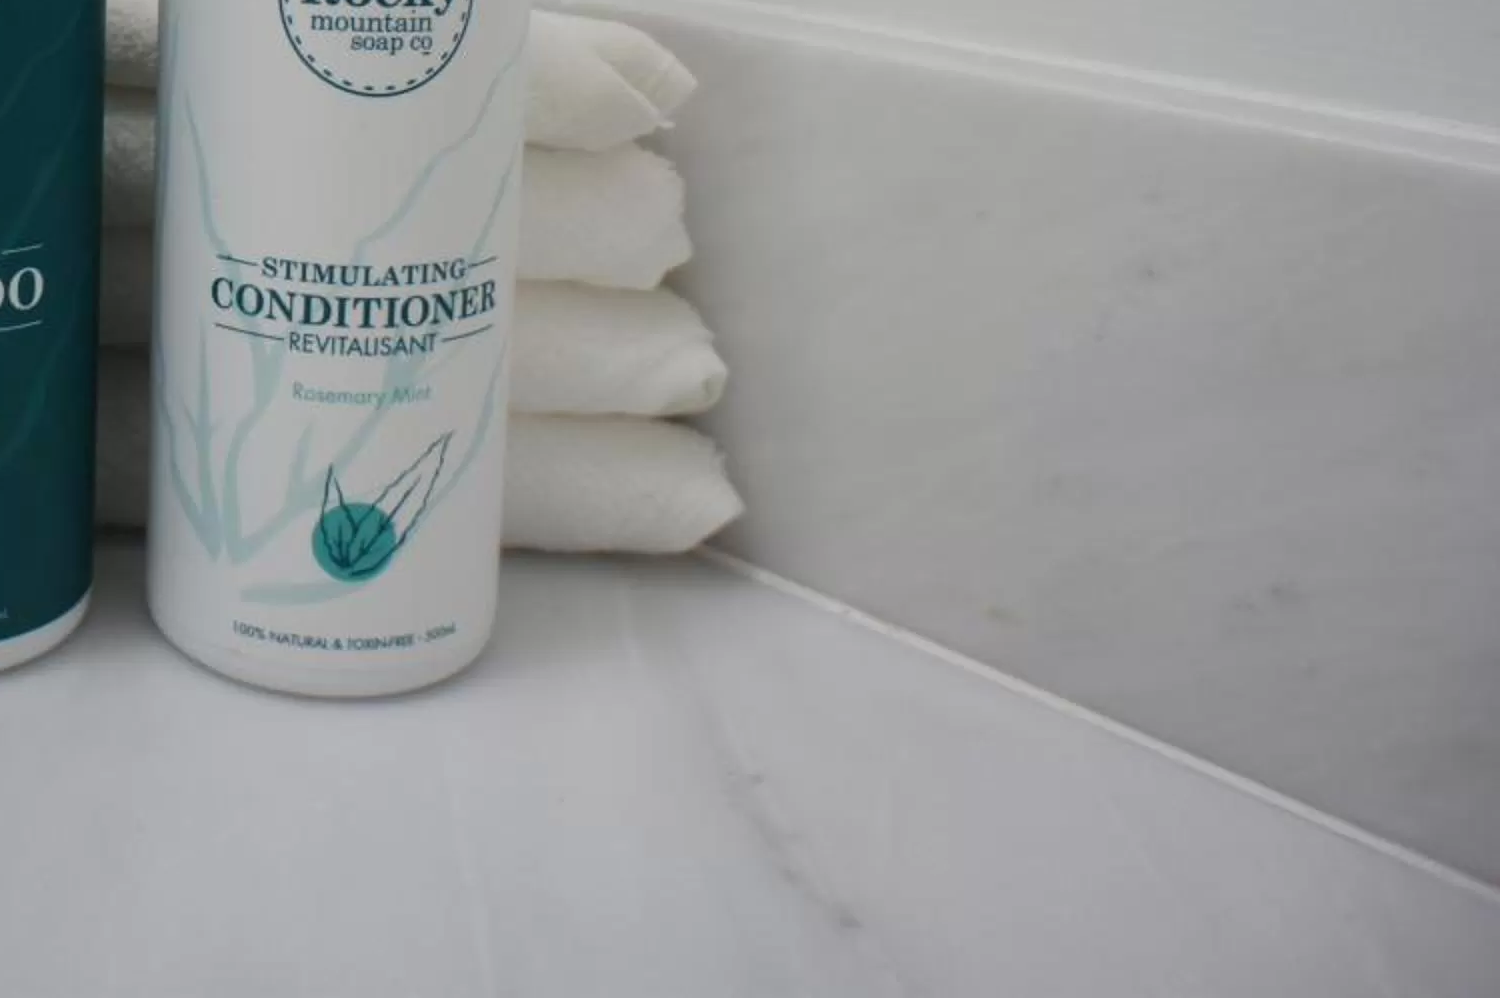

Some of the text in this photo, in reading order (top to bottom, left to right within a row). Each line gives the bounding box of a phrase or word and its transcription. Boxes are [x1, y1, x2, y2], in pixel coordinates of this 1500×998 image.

[311, 9, 432, 32] mountain
[351, 34, 433, 55] soap co
[261, 257, 467, 287] STIMULATING
[211, 277, 497, 329] CONDITIONER
[288, 331, 438, 357] REVITALISANT
[292, 381, 432, 410] Rosemary Mint
[232, 619, 266, 641] 100%
[268, 629, 329, 651] NATURAL
[332, 636, 344, 651] &
